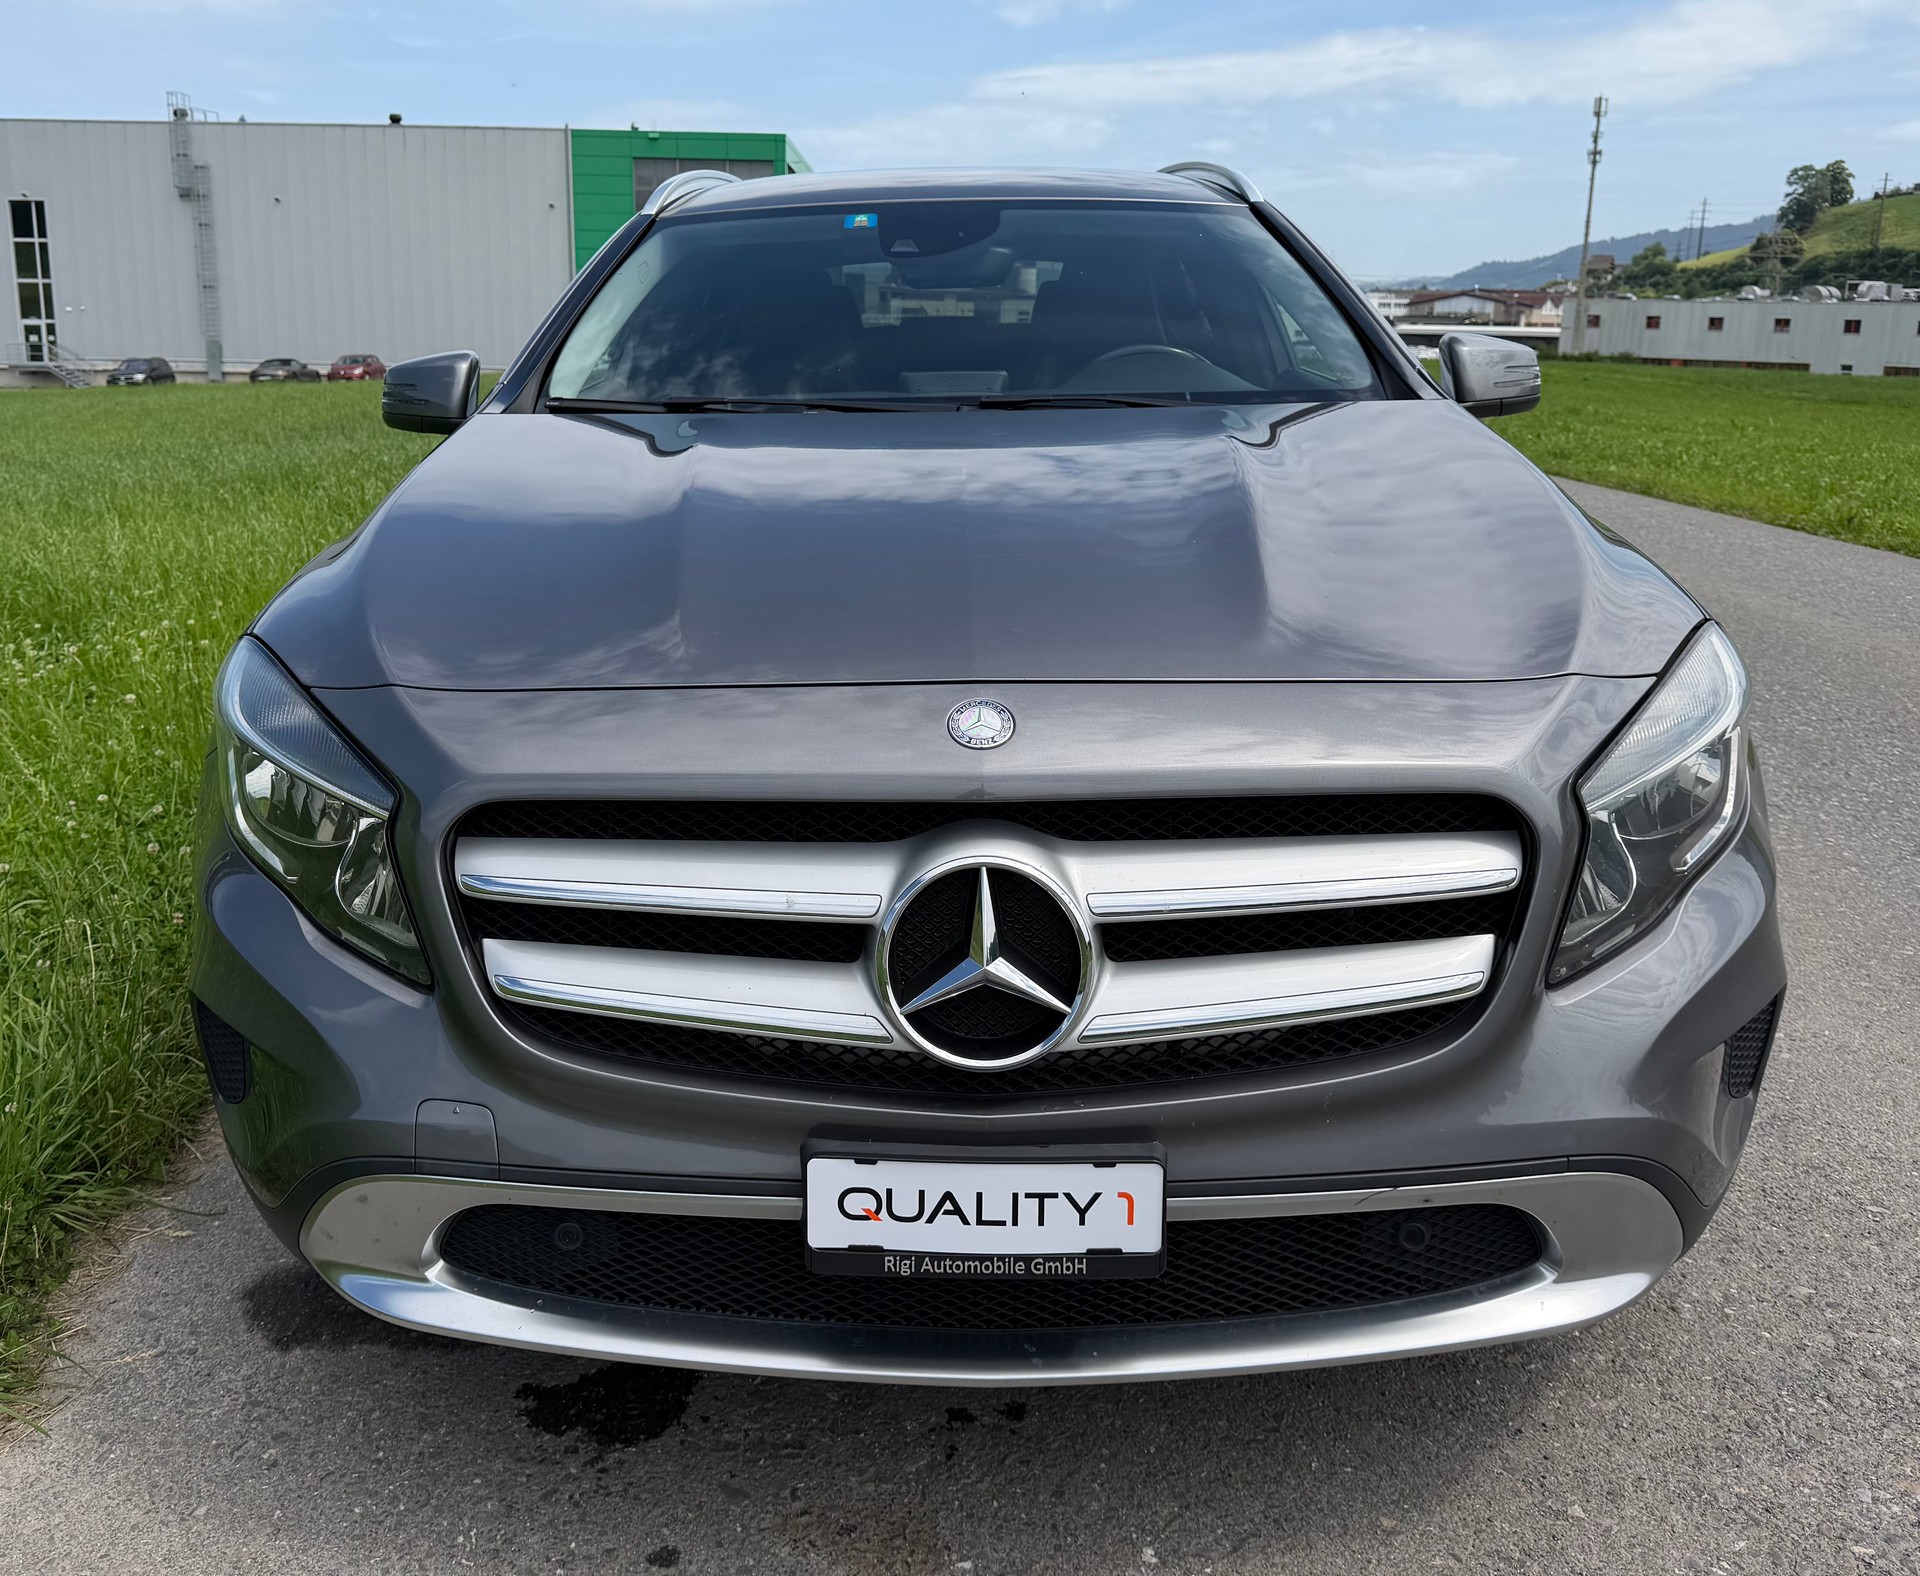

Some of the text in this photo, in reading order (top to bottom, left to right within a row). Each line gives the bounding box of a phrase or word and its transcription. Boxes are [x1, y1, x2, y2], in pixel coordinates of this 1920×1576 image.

[837, 1186, 1134, 1226] QUALITY 1
[884, 1256, 1087, 1275] Rigi Automobile GmbH
